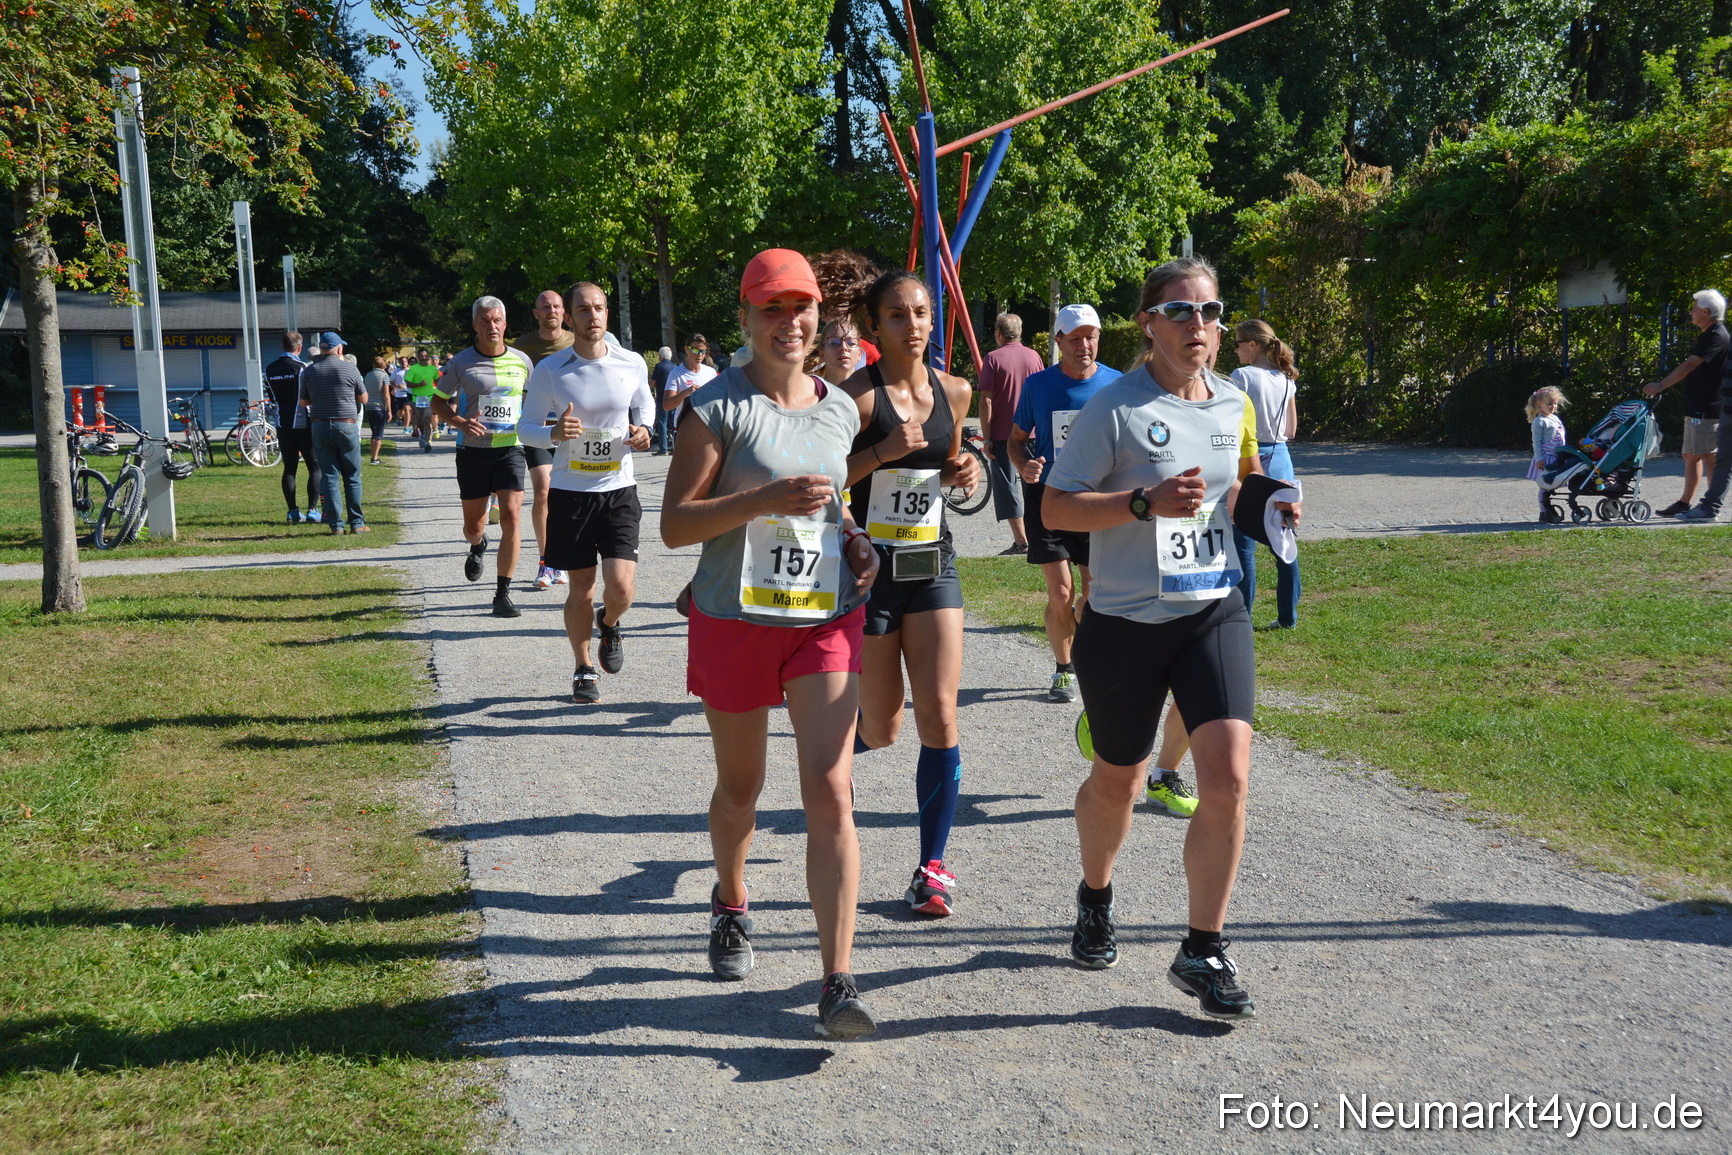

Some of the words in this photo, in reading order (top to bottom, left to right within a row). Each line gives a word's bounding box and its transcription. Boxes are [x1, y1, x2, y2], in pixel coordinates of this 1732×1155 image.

[123, 335, 187, 347] SAFE
[484, 405, 512, 418] 2894
[1210, 434, 1237, 447] BOC
[583, 441, 611, 456] 138
[1149, 450, 1175, 458] PARTL
[580, 463, 611, 471] Sebastian
[896, 475, 929, 486] BOCK
[891, 490, 930, 515] 135
[777, 527, 815, 540] BOCK
[895, 527, 918, 539] Elisa
[1170, 528, 1225, 560] 3117
[770, 545, 821, 577] 157
[1179, 562, 1198, 570] PARTL
[763, 578, 785, 587] PARTL
[786, 579, 813, 588] Neumarkt
[773, 592, 809, 607] Maren
